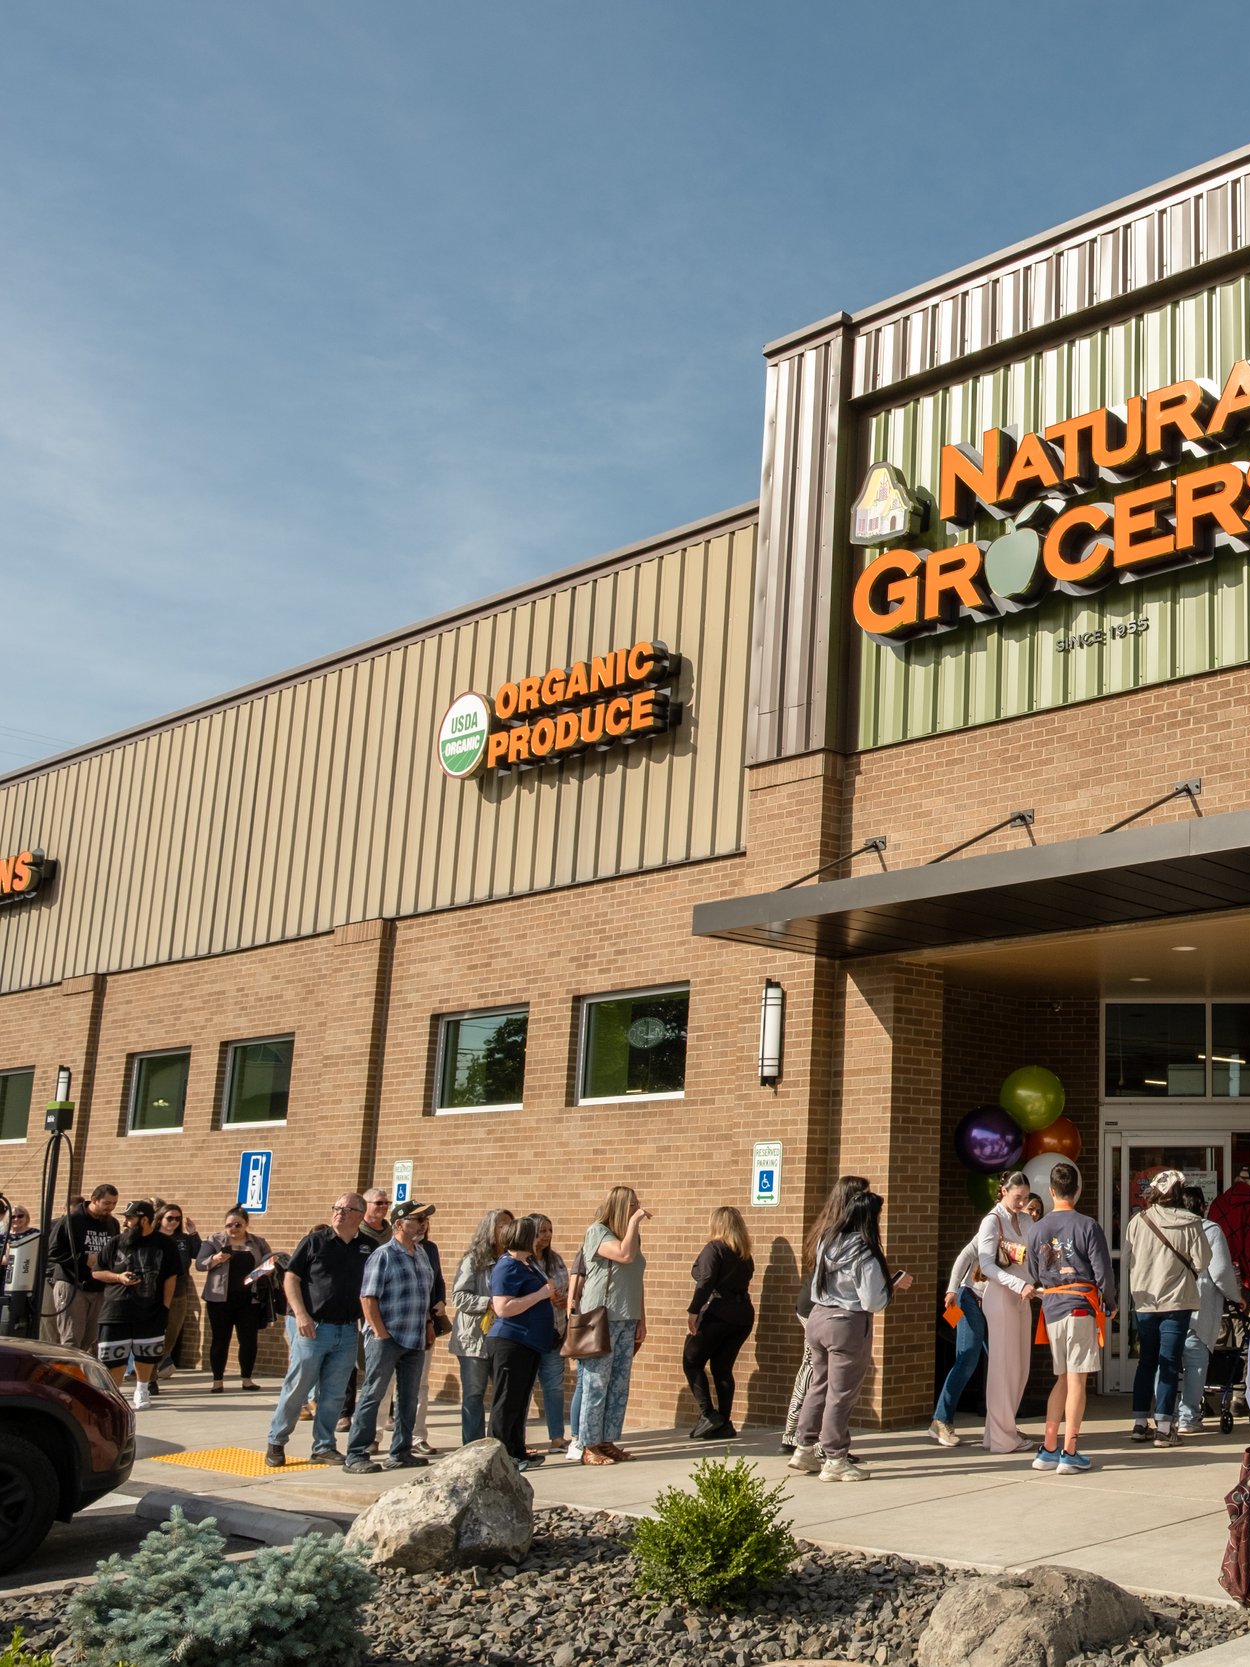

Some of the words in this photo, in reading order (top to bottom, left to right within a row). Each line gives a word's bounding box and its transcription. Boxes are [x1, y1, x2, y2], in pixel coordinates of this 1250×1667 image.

[1056, 628, 1104, 653] SINCE
[1109, 617, 1151, 641] 1955
[495, 641, 655, 719] ORGANIC
[451, 711, 478, 734] USDA
[487, 689, 656, 768] PRODUCE
[445, 735, 480, 757] ORGANIC
[756, 1148, 780, 1157] RESERVED
[757, 1158, 778, 1167] PARKING
